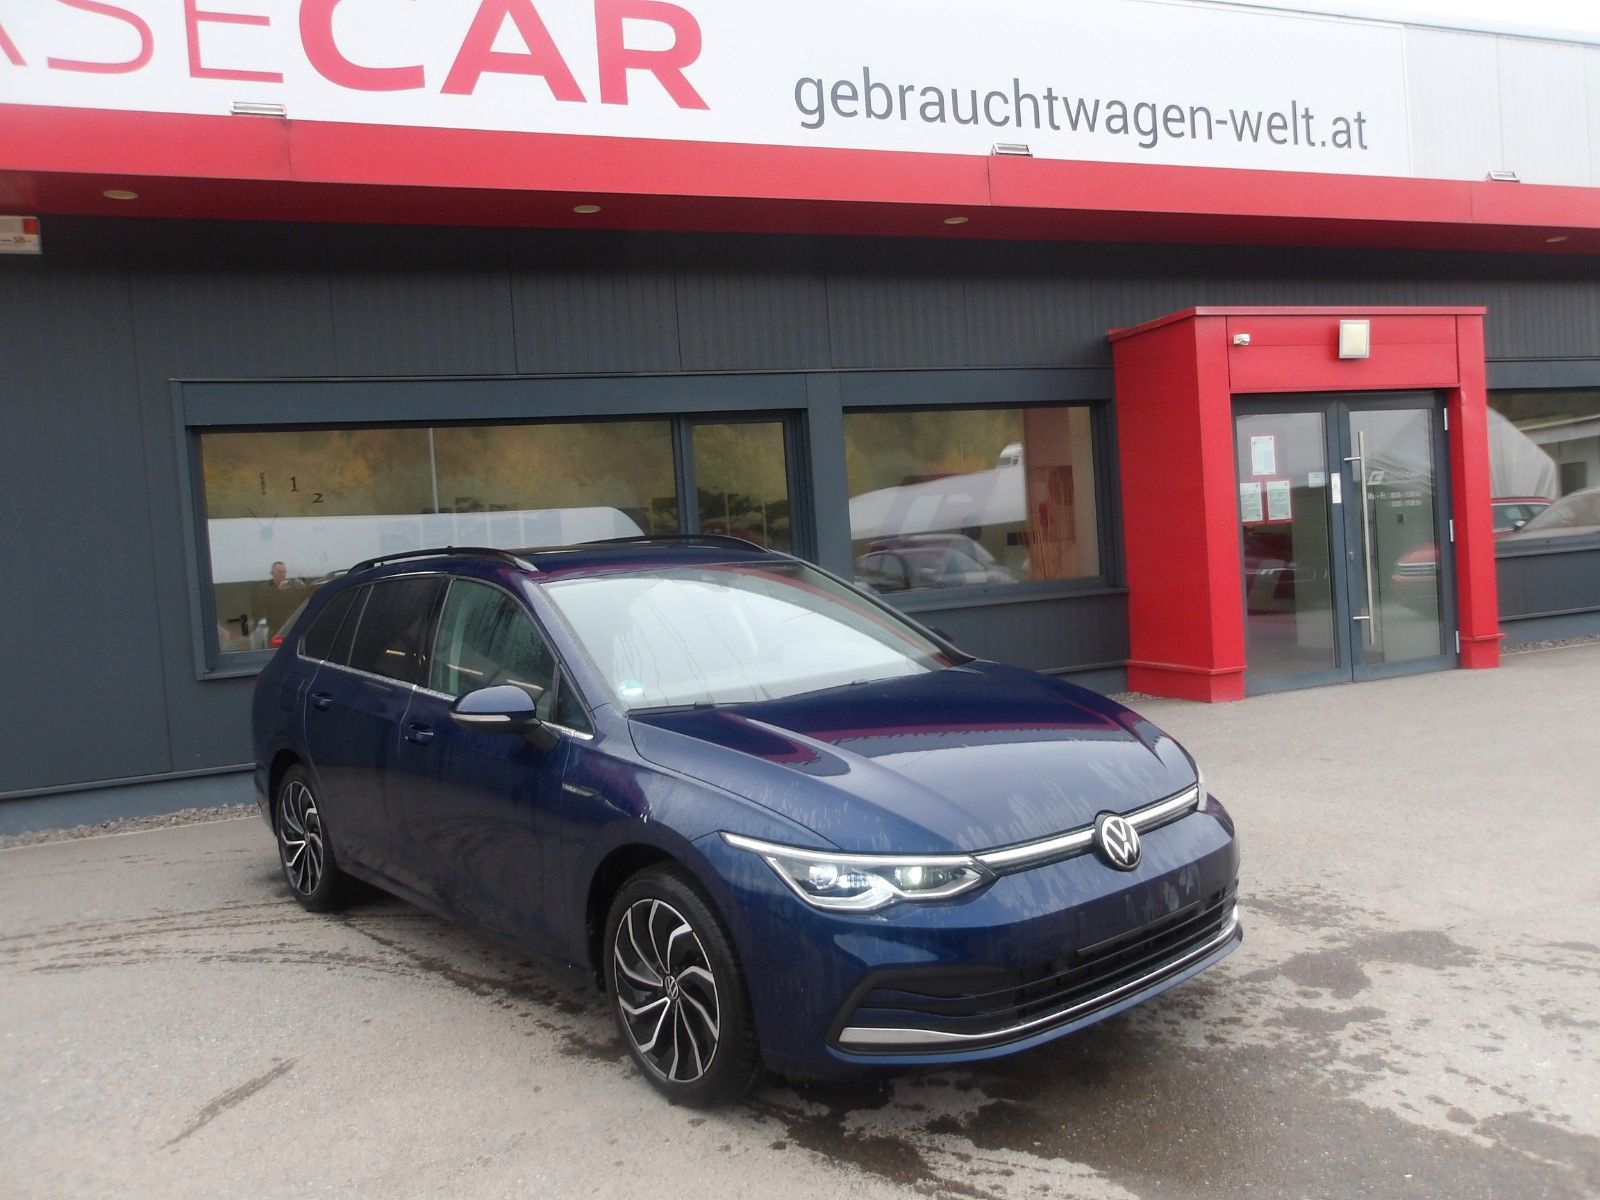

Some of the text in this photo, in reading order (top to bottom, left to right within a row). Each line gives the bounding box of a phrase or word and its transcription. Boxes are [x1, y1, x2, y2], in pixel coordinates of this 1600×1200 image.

[794, 66, 1368, 150] gebrauchtwagen-welt.at
[290, 476, 299, 492] 1
[312, 492, 323, 503] 2
[1102, 816, 1141, 867] VW
